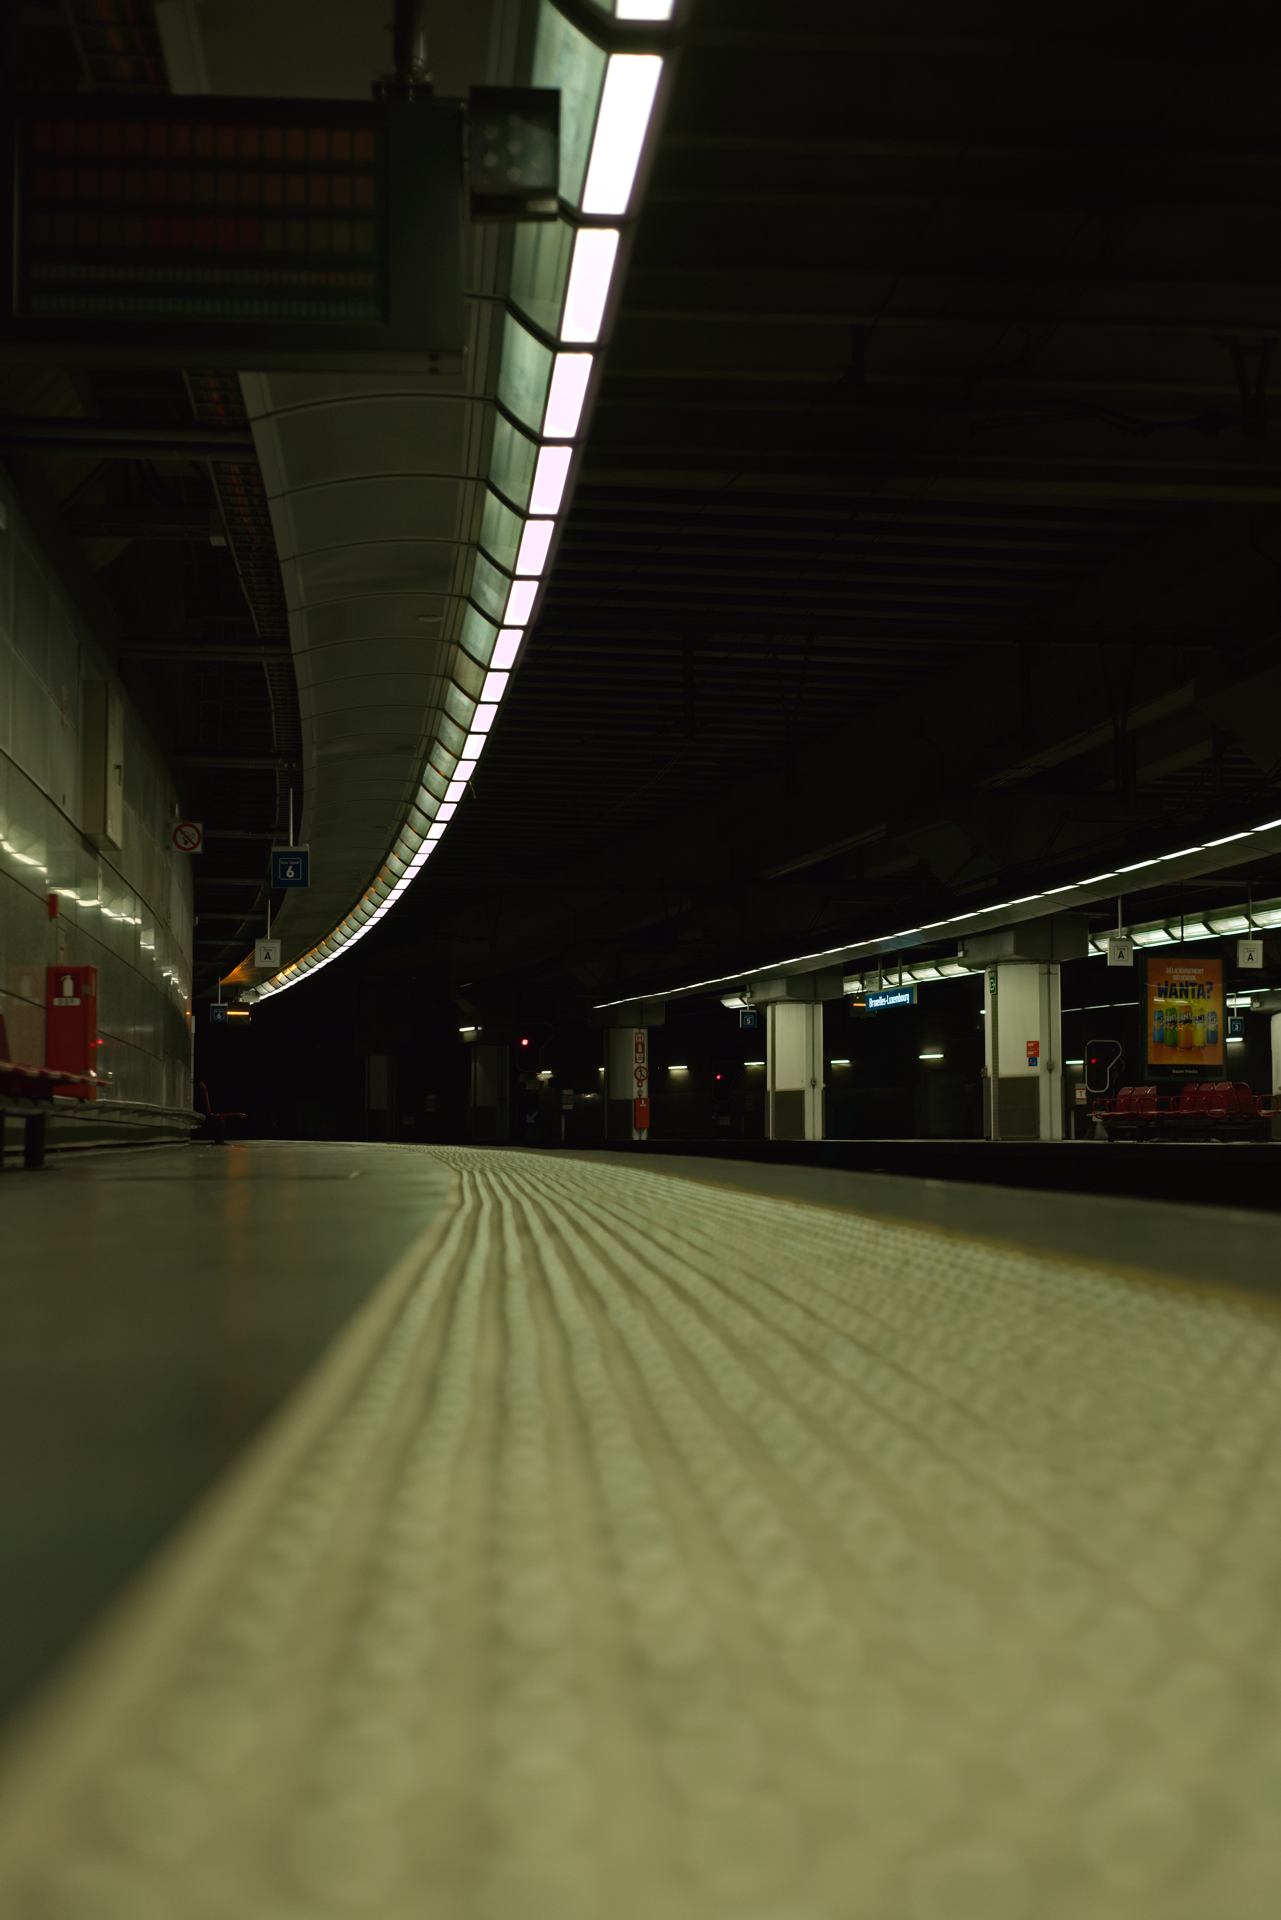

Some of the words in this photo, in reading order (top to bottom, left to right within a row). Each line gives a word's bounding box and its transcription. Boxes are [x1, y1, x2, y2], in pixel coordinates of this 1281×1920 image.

[286, 865, 295, 878] 6
[264, 951, 272, 961] A
[1118, 951, 1125, 959] A
[1247, 953, 1254, 961] A
[1157, 980, 1214, 999] WANTA?
